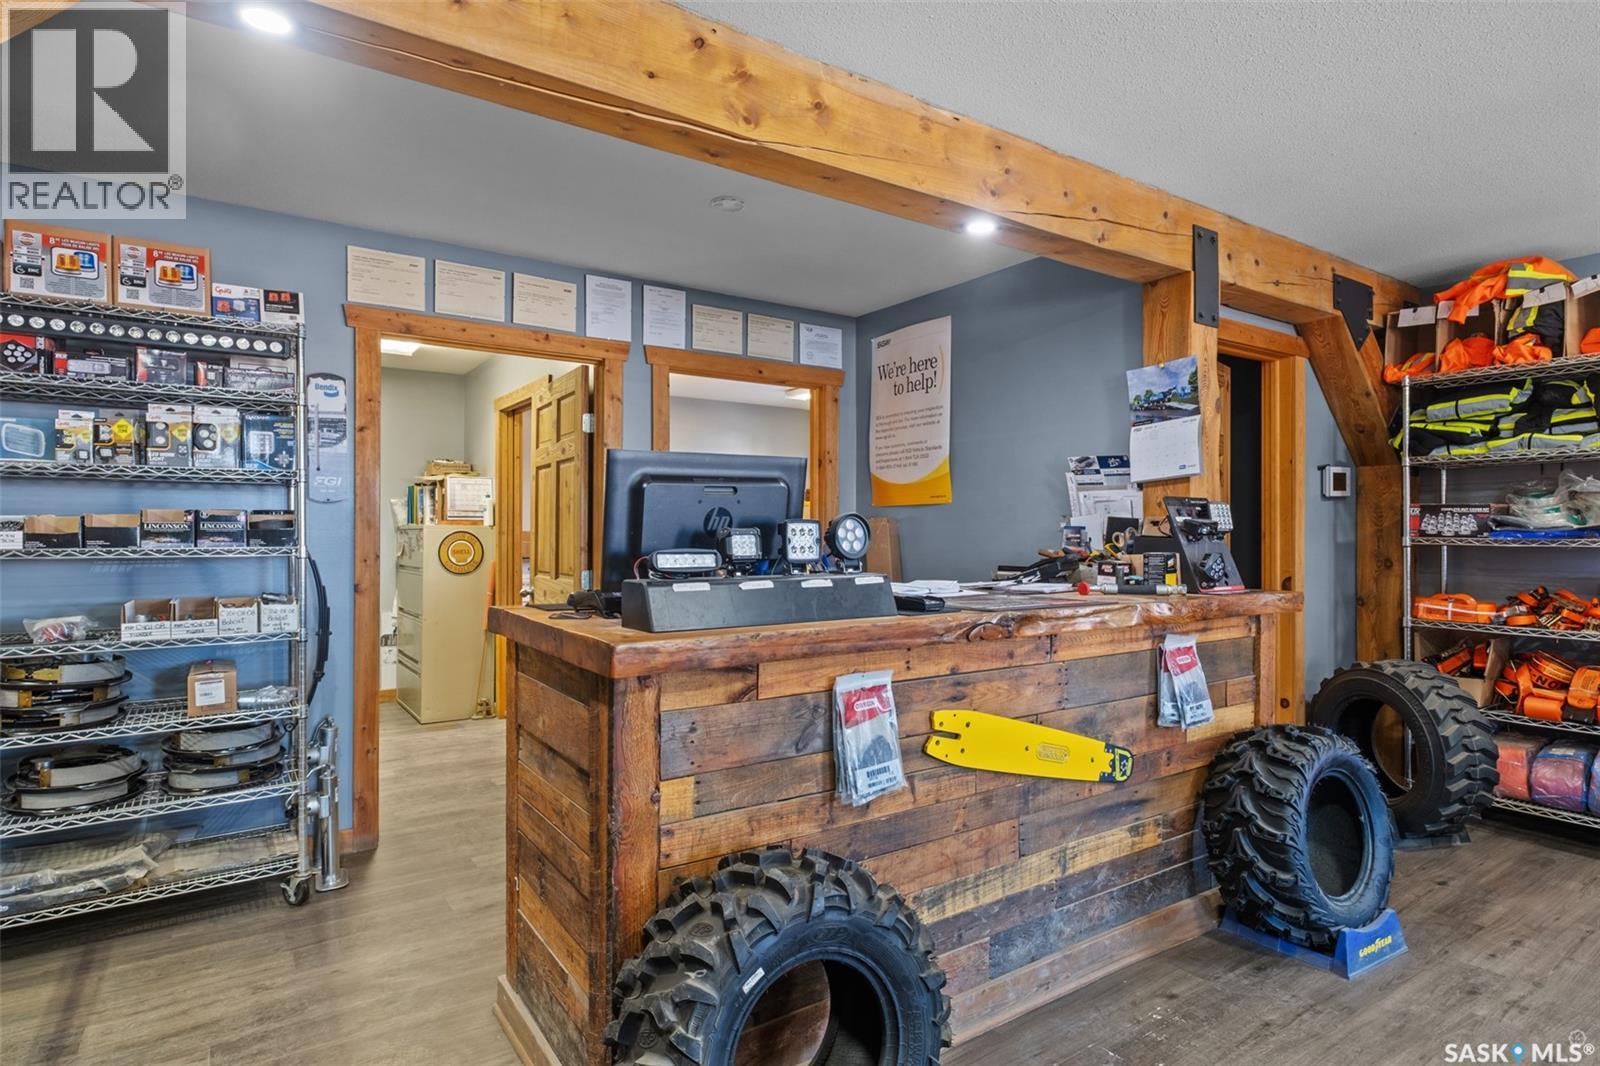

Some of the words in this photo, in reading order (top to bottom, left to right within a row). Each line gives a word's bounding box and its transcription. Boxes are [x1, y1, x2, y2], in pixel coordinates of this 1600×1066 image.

[877, 361, 907, 381] We're
[909, 355, 938, 374] here
[314, 382, 338, 391] Bendix
[894, 381, 904, 396] to
[906, 370, 937, 394] help!
[708, 506, 731, 530] hp
[1358, 935, 1392, 958] GOODYEAR
